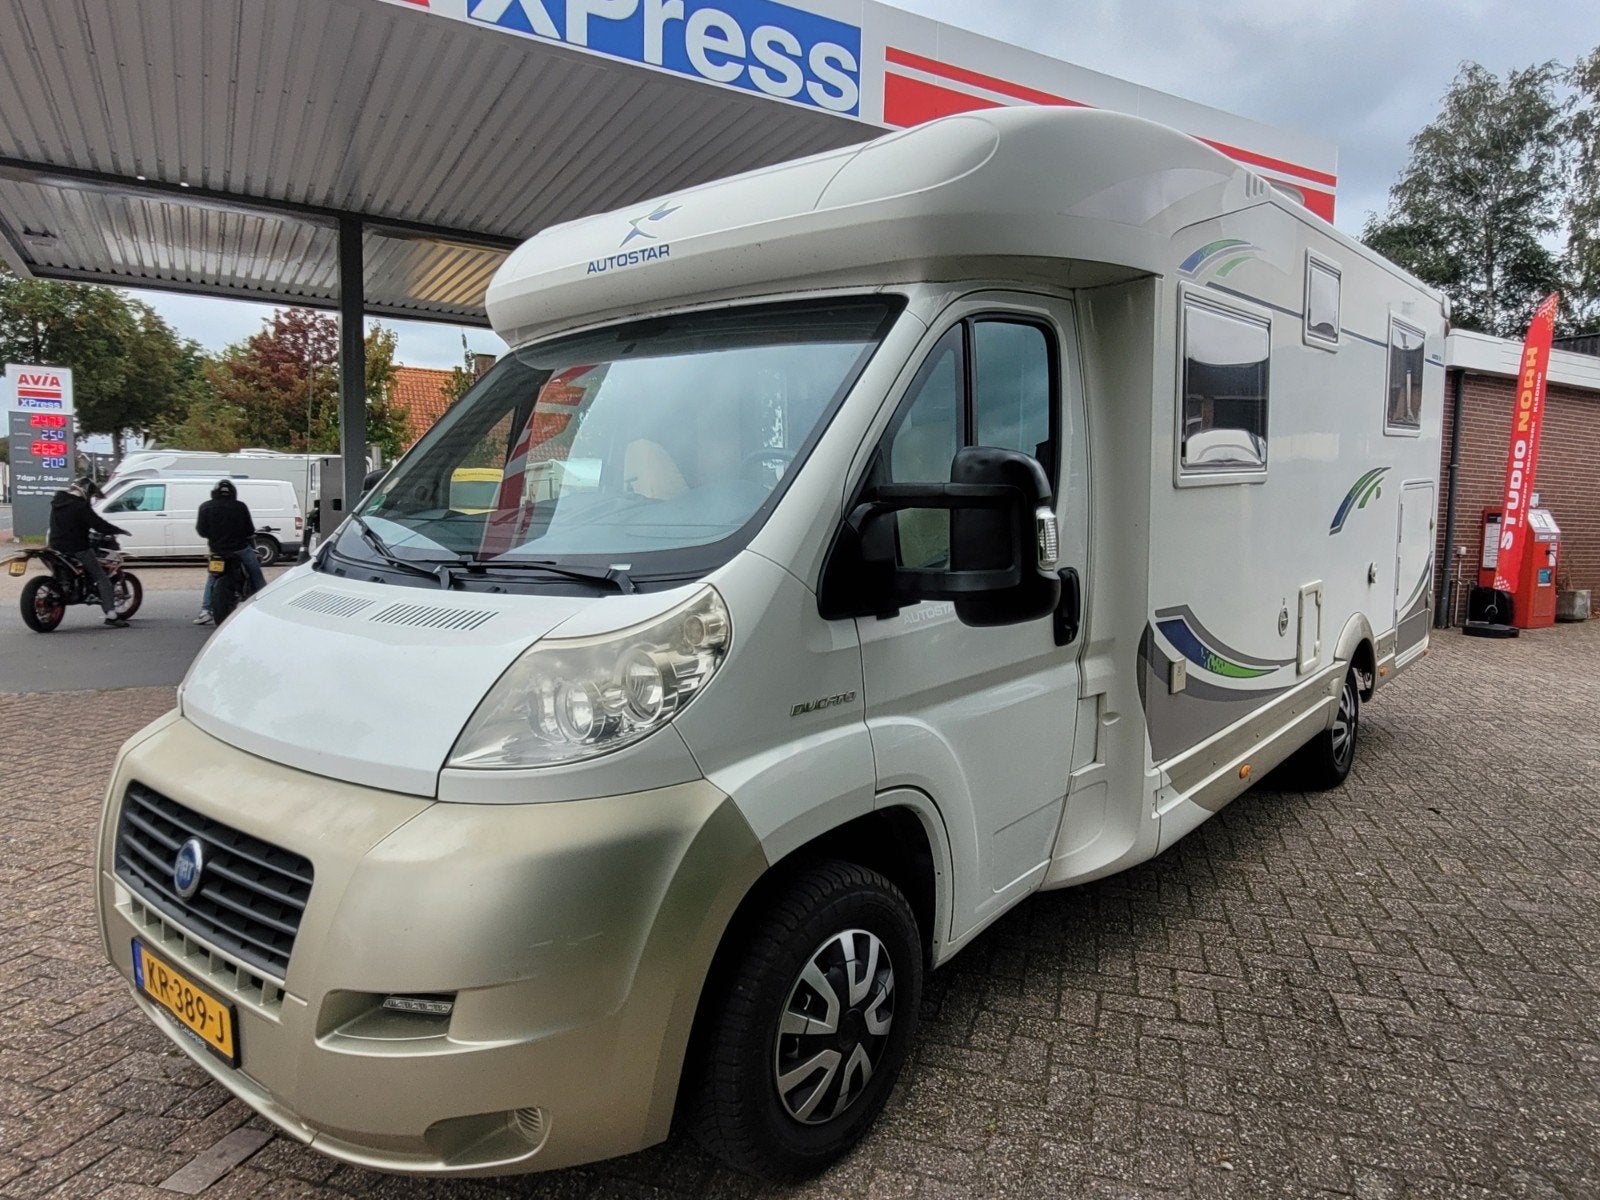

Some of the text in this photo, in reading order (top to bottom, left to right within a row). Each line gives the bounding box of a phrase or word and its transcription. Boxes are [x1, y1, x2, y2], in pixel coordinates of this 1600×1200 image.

[587, 244, 670, 275] AUTOSTAR
[20, 399, 62, 409] XPress
[1533, 371, 1542, 413] KLEDING
[1501, 347, 1538, 550] STUDIO NOAH
[903, 602, 955, 625] AUTOSTA
[146, 958, 225, 1044] KR-389-J
